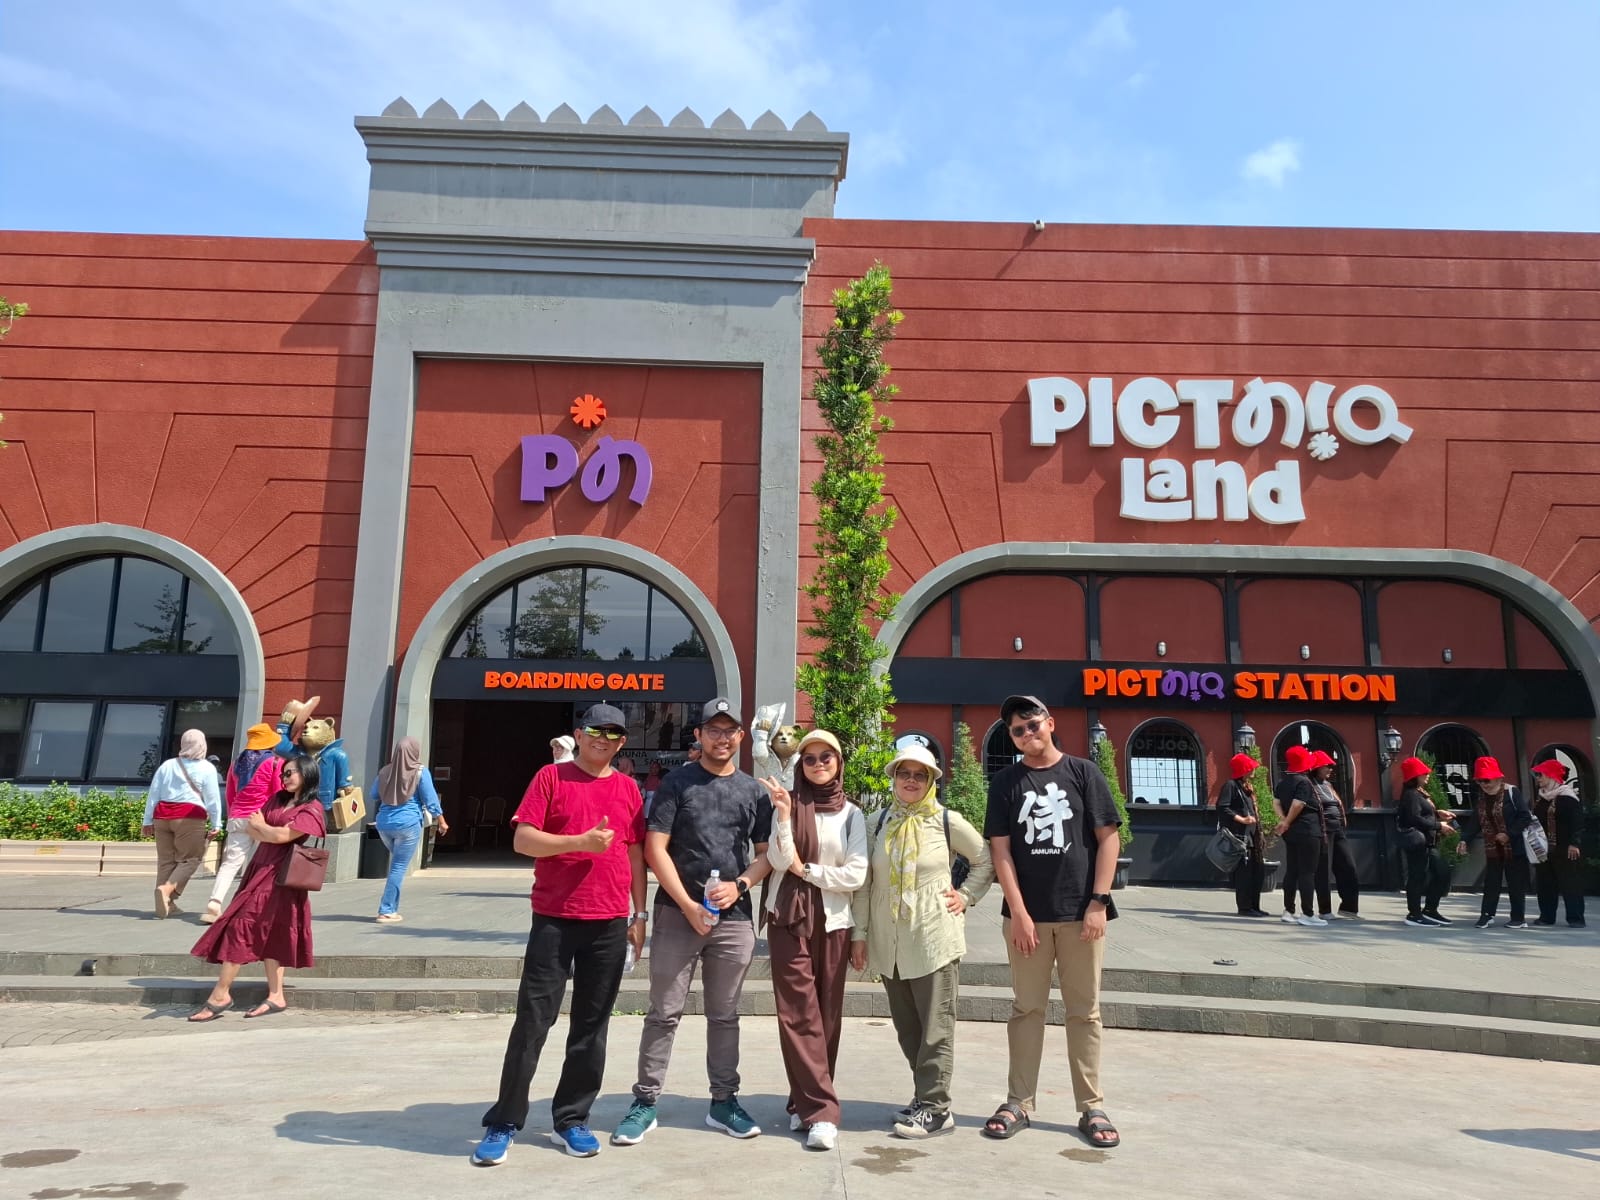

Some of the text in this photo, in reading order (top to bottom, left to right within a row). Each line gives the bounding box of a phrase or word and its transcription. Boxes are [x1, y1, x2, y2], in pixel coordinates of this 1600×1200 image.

[484, 671, 665, 691] BOARDING GATE
[1233, 671, 1397, 703] STATION
[1017, 781, 1074, 848] 侍
